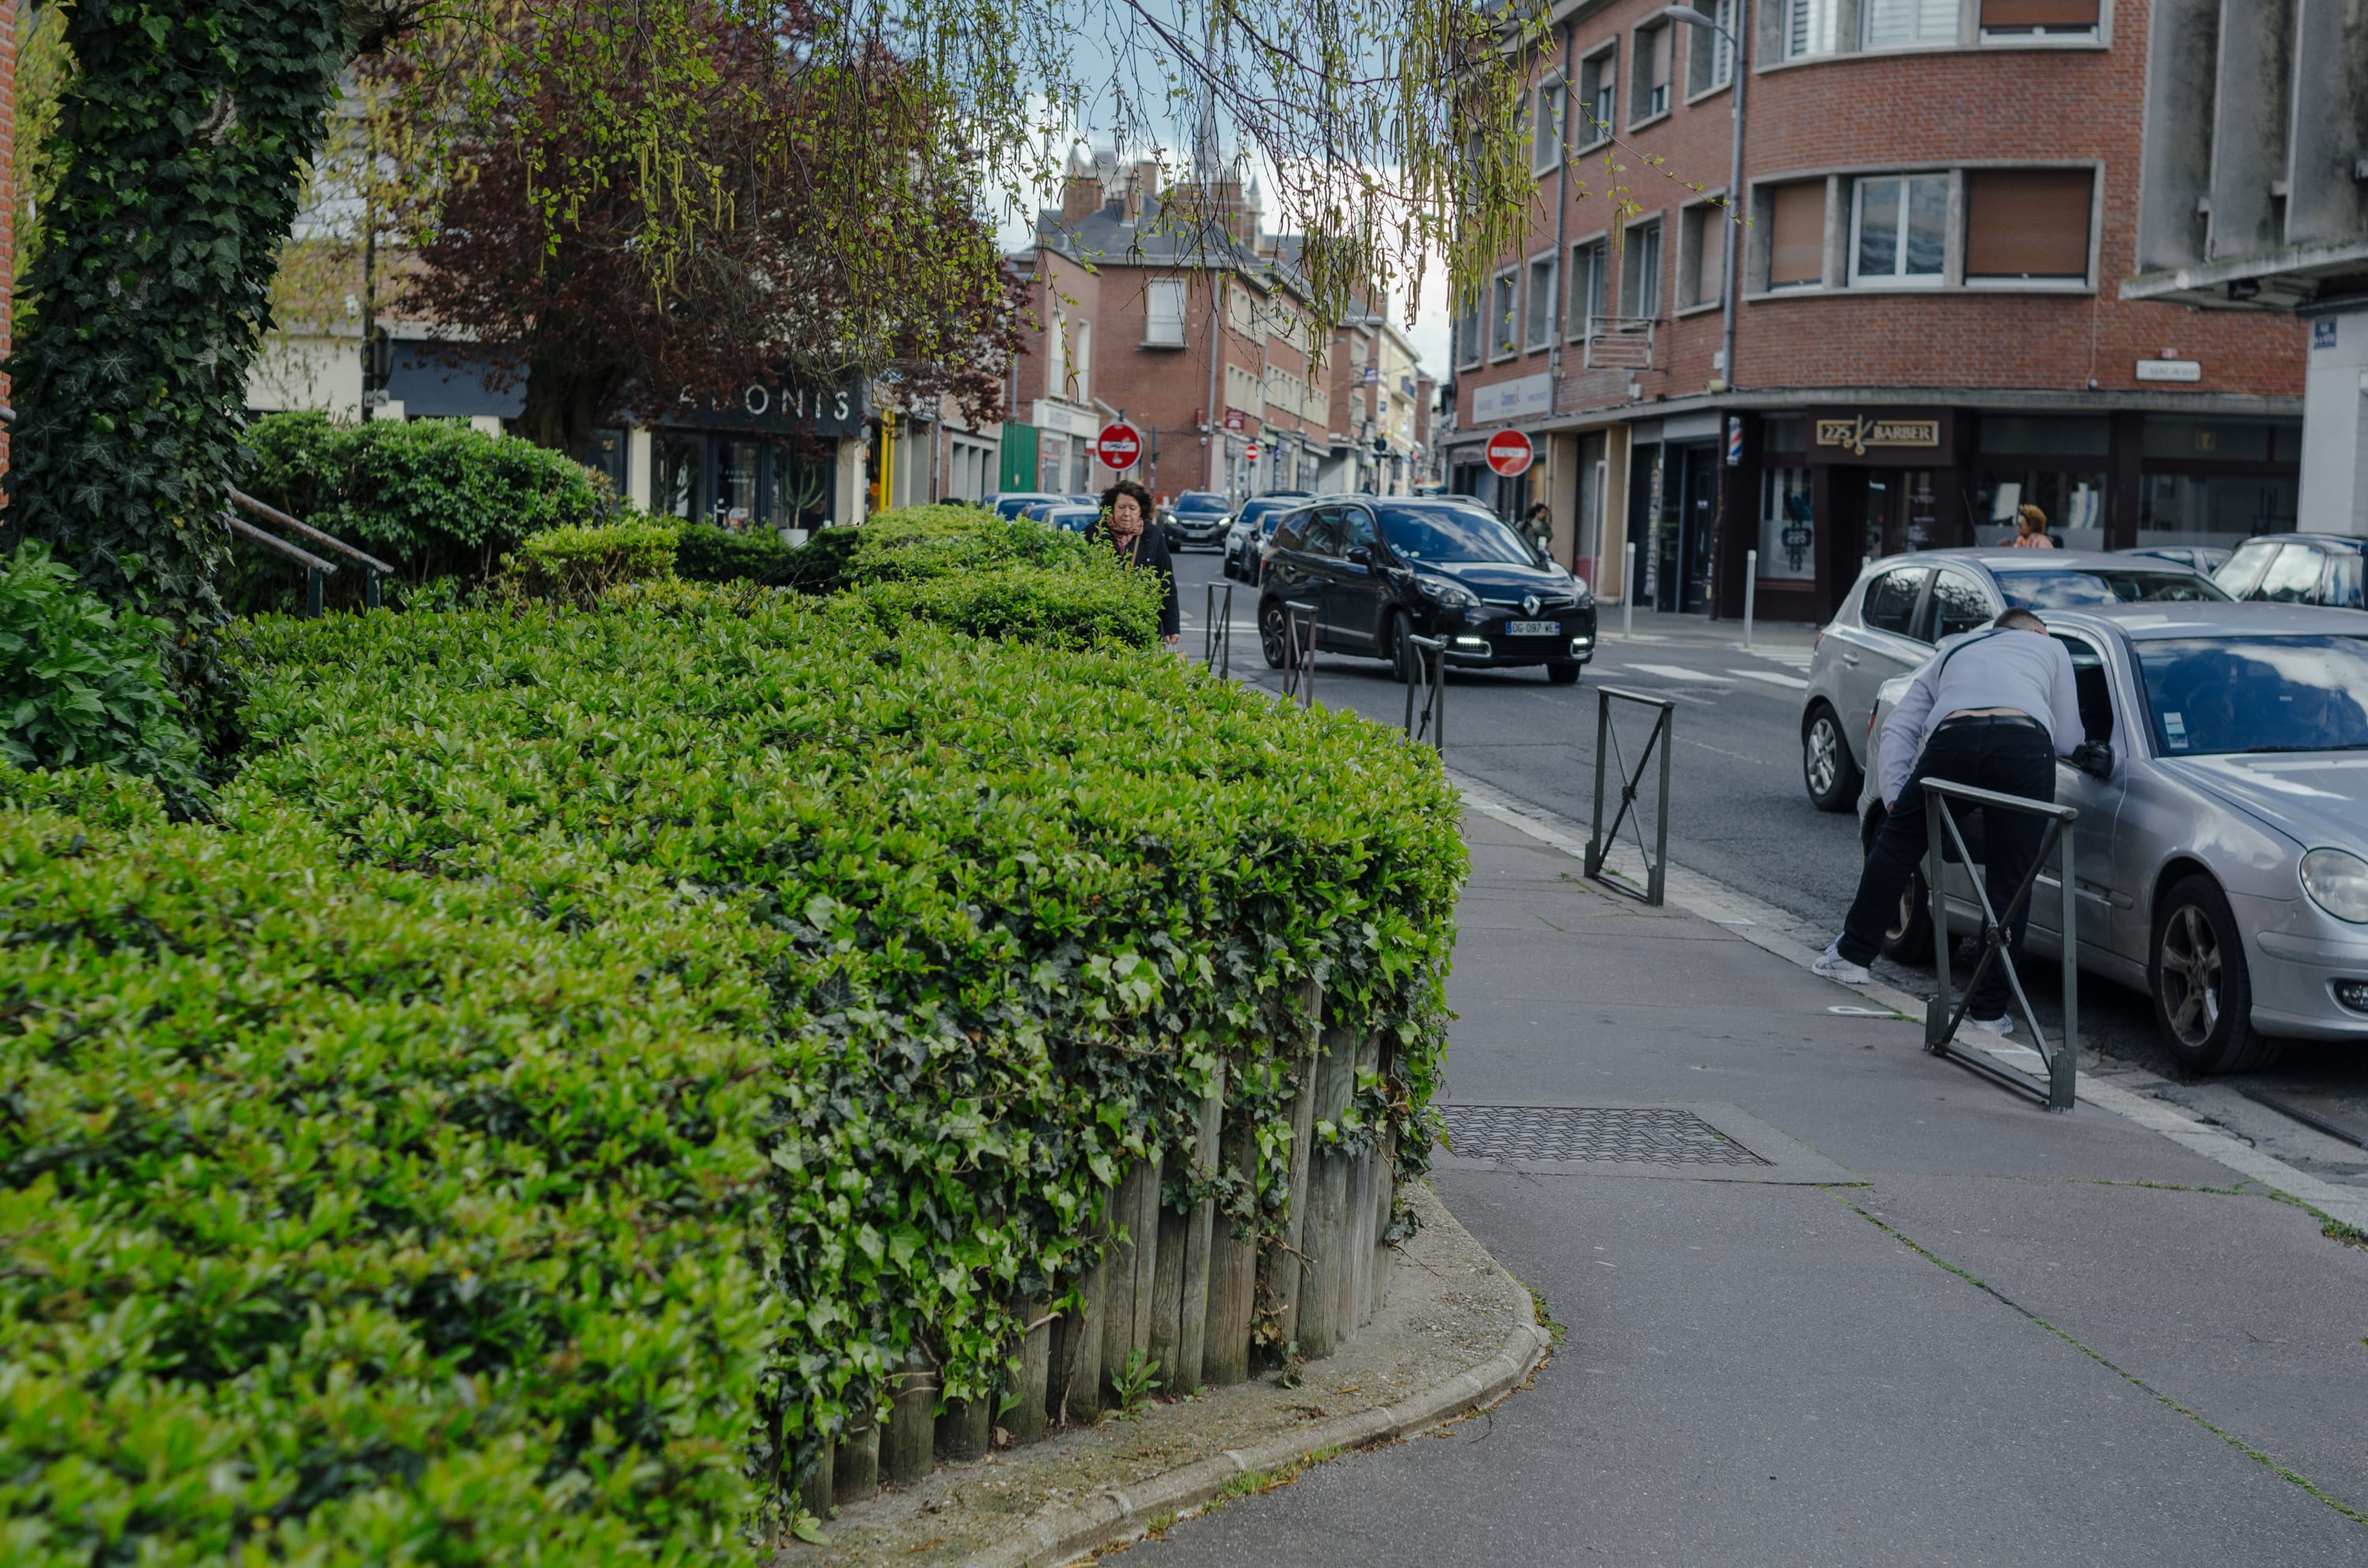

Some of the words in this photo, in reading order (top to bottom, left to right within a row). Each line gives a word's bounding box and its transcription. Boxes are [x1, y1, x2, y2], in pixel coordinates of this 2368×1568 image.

[1824, 425, 1851, 440] 225
[1873, 425, 1931, 440] BARBER
[1786, 530, 1807, 545] 225
